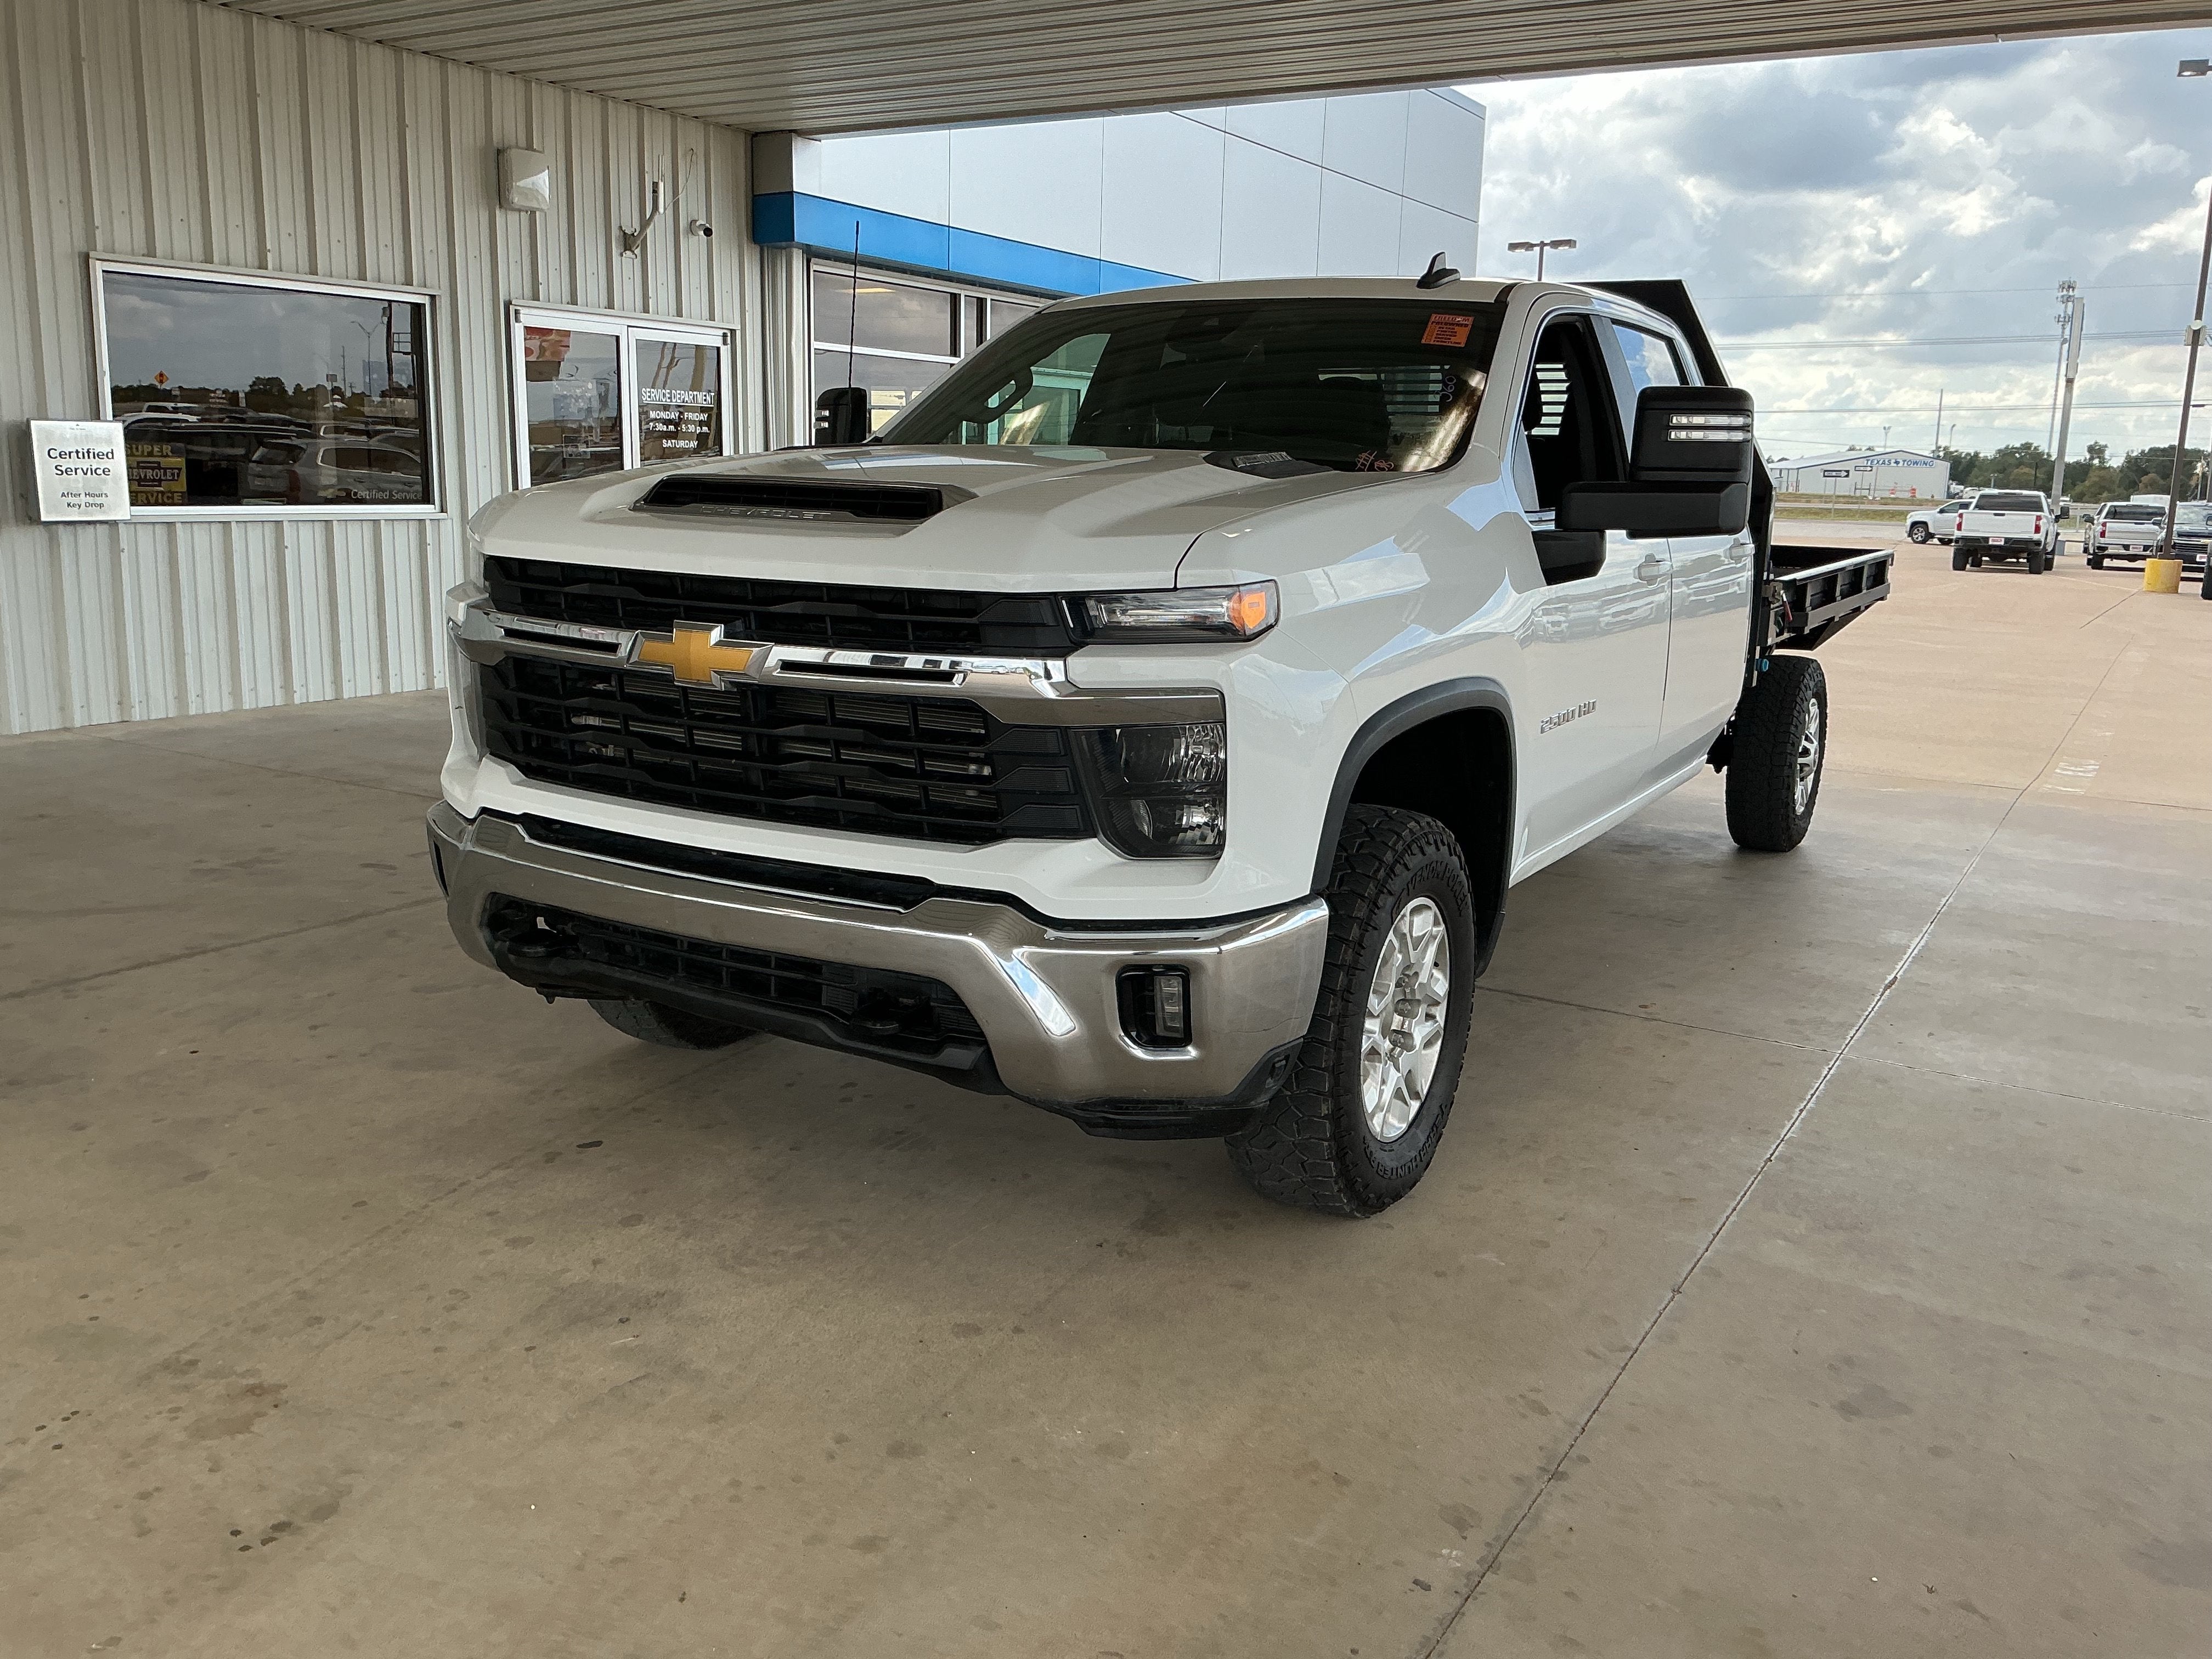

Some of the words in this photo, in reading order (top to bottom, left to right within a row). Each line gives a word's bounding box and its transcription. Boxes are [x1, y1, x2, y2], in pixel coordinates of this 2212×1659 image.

[641, 387, 671, 402] SERVICE
[672, 390, 715, 404] DEPARTMENT
[650, 410, 679, 420] MONDAY
[684, 412, 708, 421] FRIDAY
[649, 422, 676, 432] 7:30a.m.
[682, 424, 695, 432] 5:30
[696, 426, 710, 434] p.m.
[662, 439, 698, 448] SATURDAY
[47, 447, 115, 460] Certified
[54, 464, 111, 476] Service
[130, 493, 182, 503] ERVICE
[351, 489, 390, 499] Certified
[392, 490, 422, 500] Service
[66, 501, 82, 510] Key
[1578, 698, 1597, 718] HD
